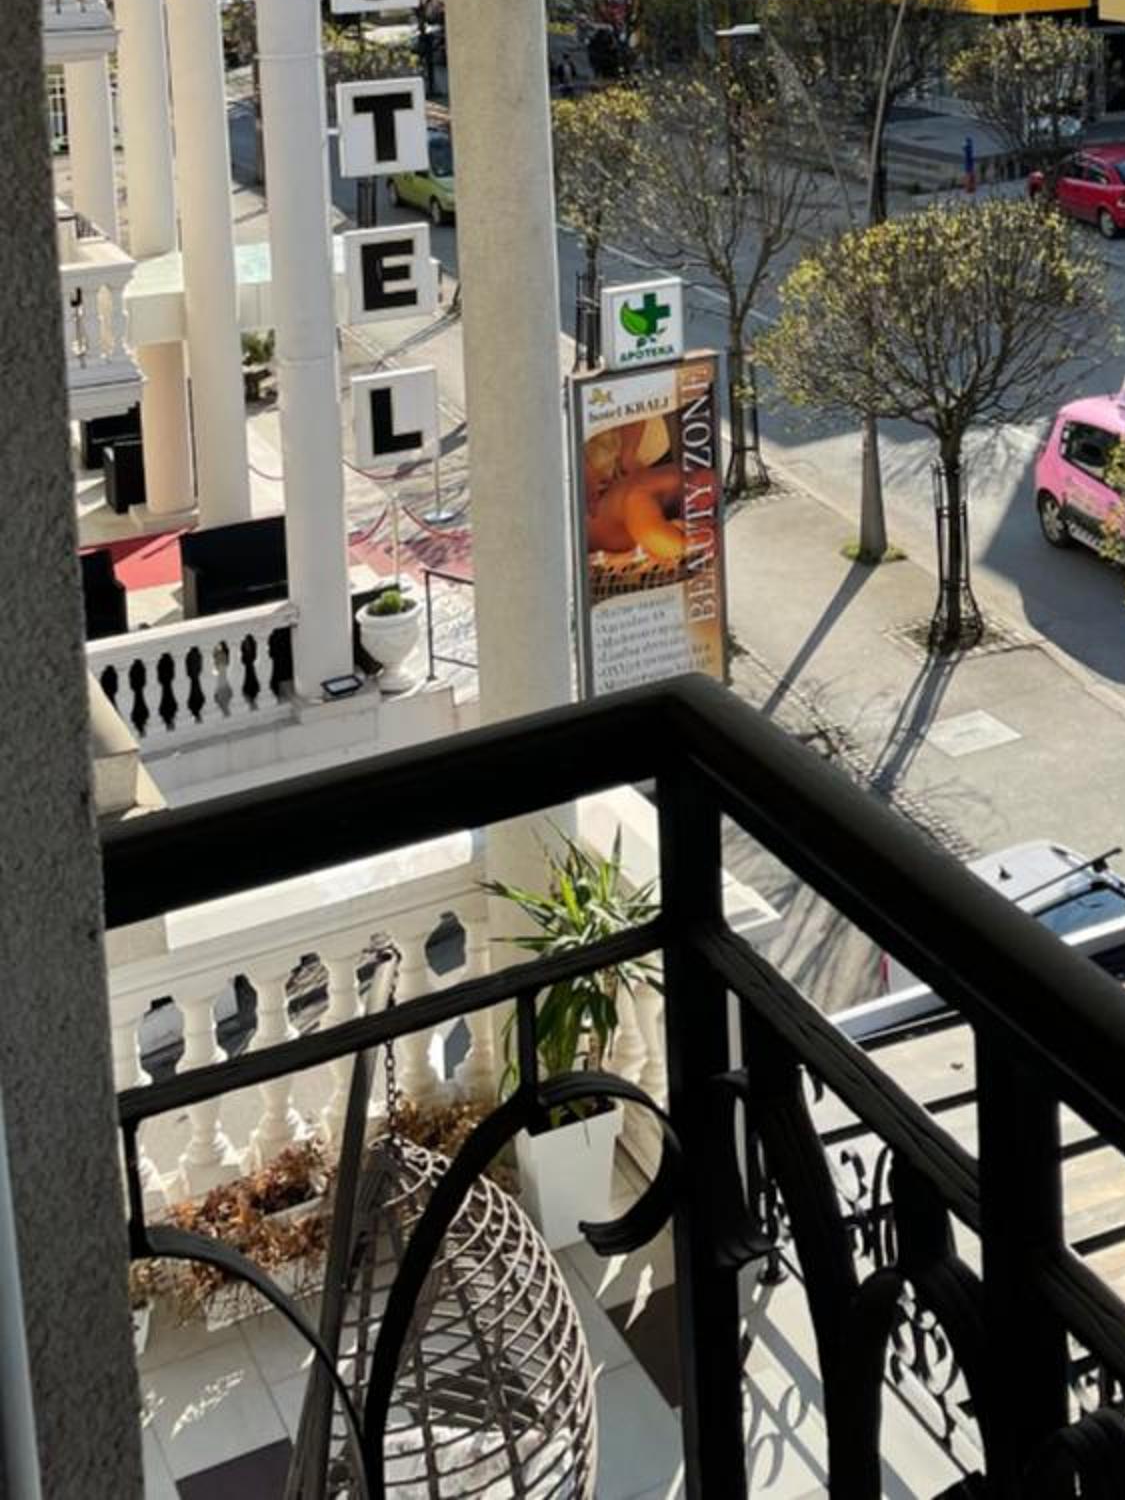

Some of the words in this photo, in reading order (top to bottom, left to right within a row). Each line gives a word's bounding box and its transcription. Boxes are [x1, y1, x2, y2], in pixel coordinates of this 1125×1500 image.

[619, 345, 674, 361] APOTEKA
[682, 365, 712, 471] ZONE
[685, 484, 716, 622] BEAUTY
